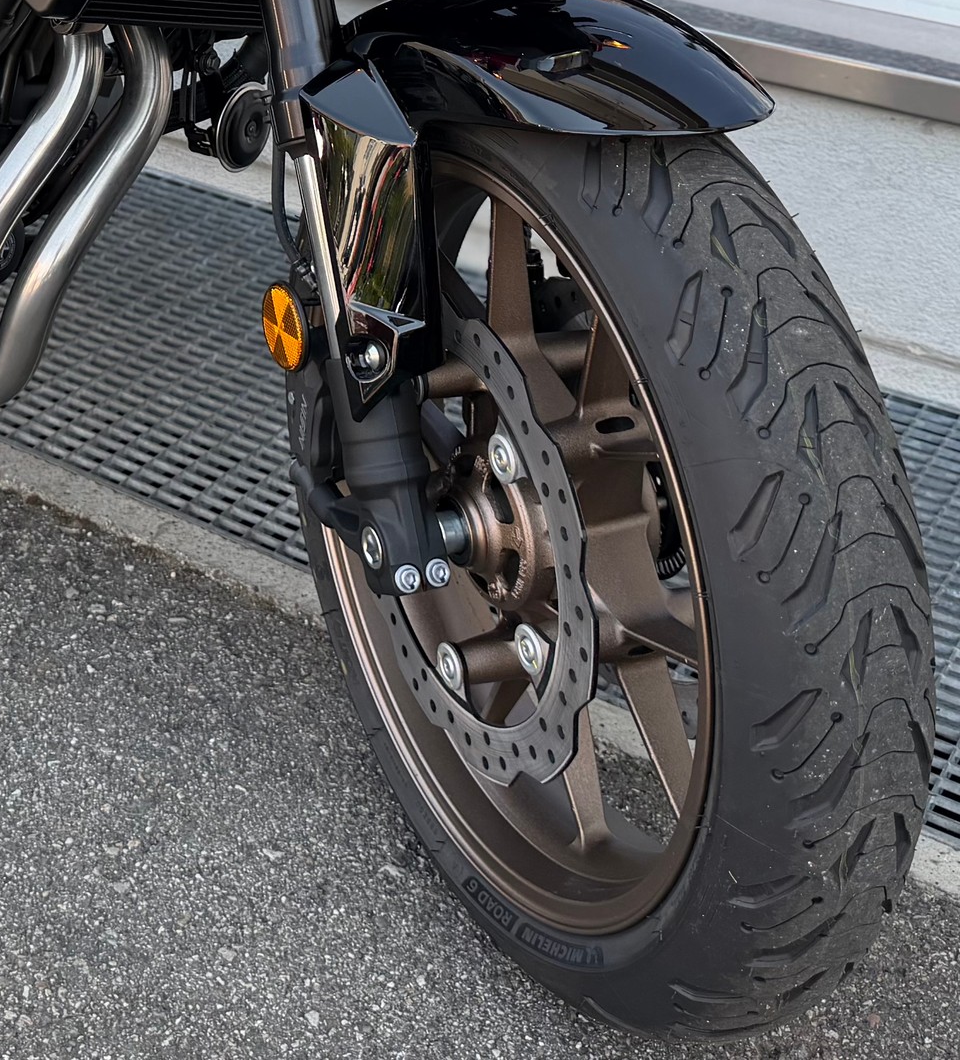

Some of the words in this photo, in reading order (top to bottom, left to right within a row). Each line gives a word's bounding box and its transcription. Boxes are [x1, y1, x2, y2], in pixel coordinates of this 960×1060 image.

[466, 879, 479, 891] 6
[477, 891, 513, 928] ROAD
[521, 925, 585, 964] MICHELIN
